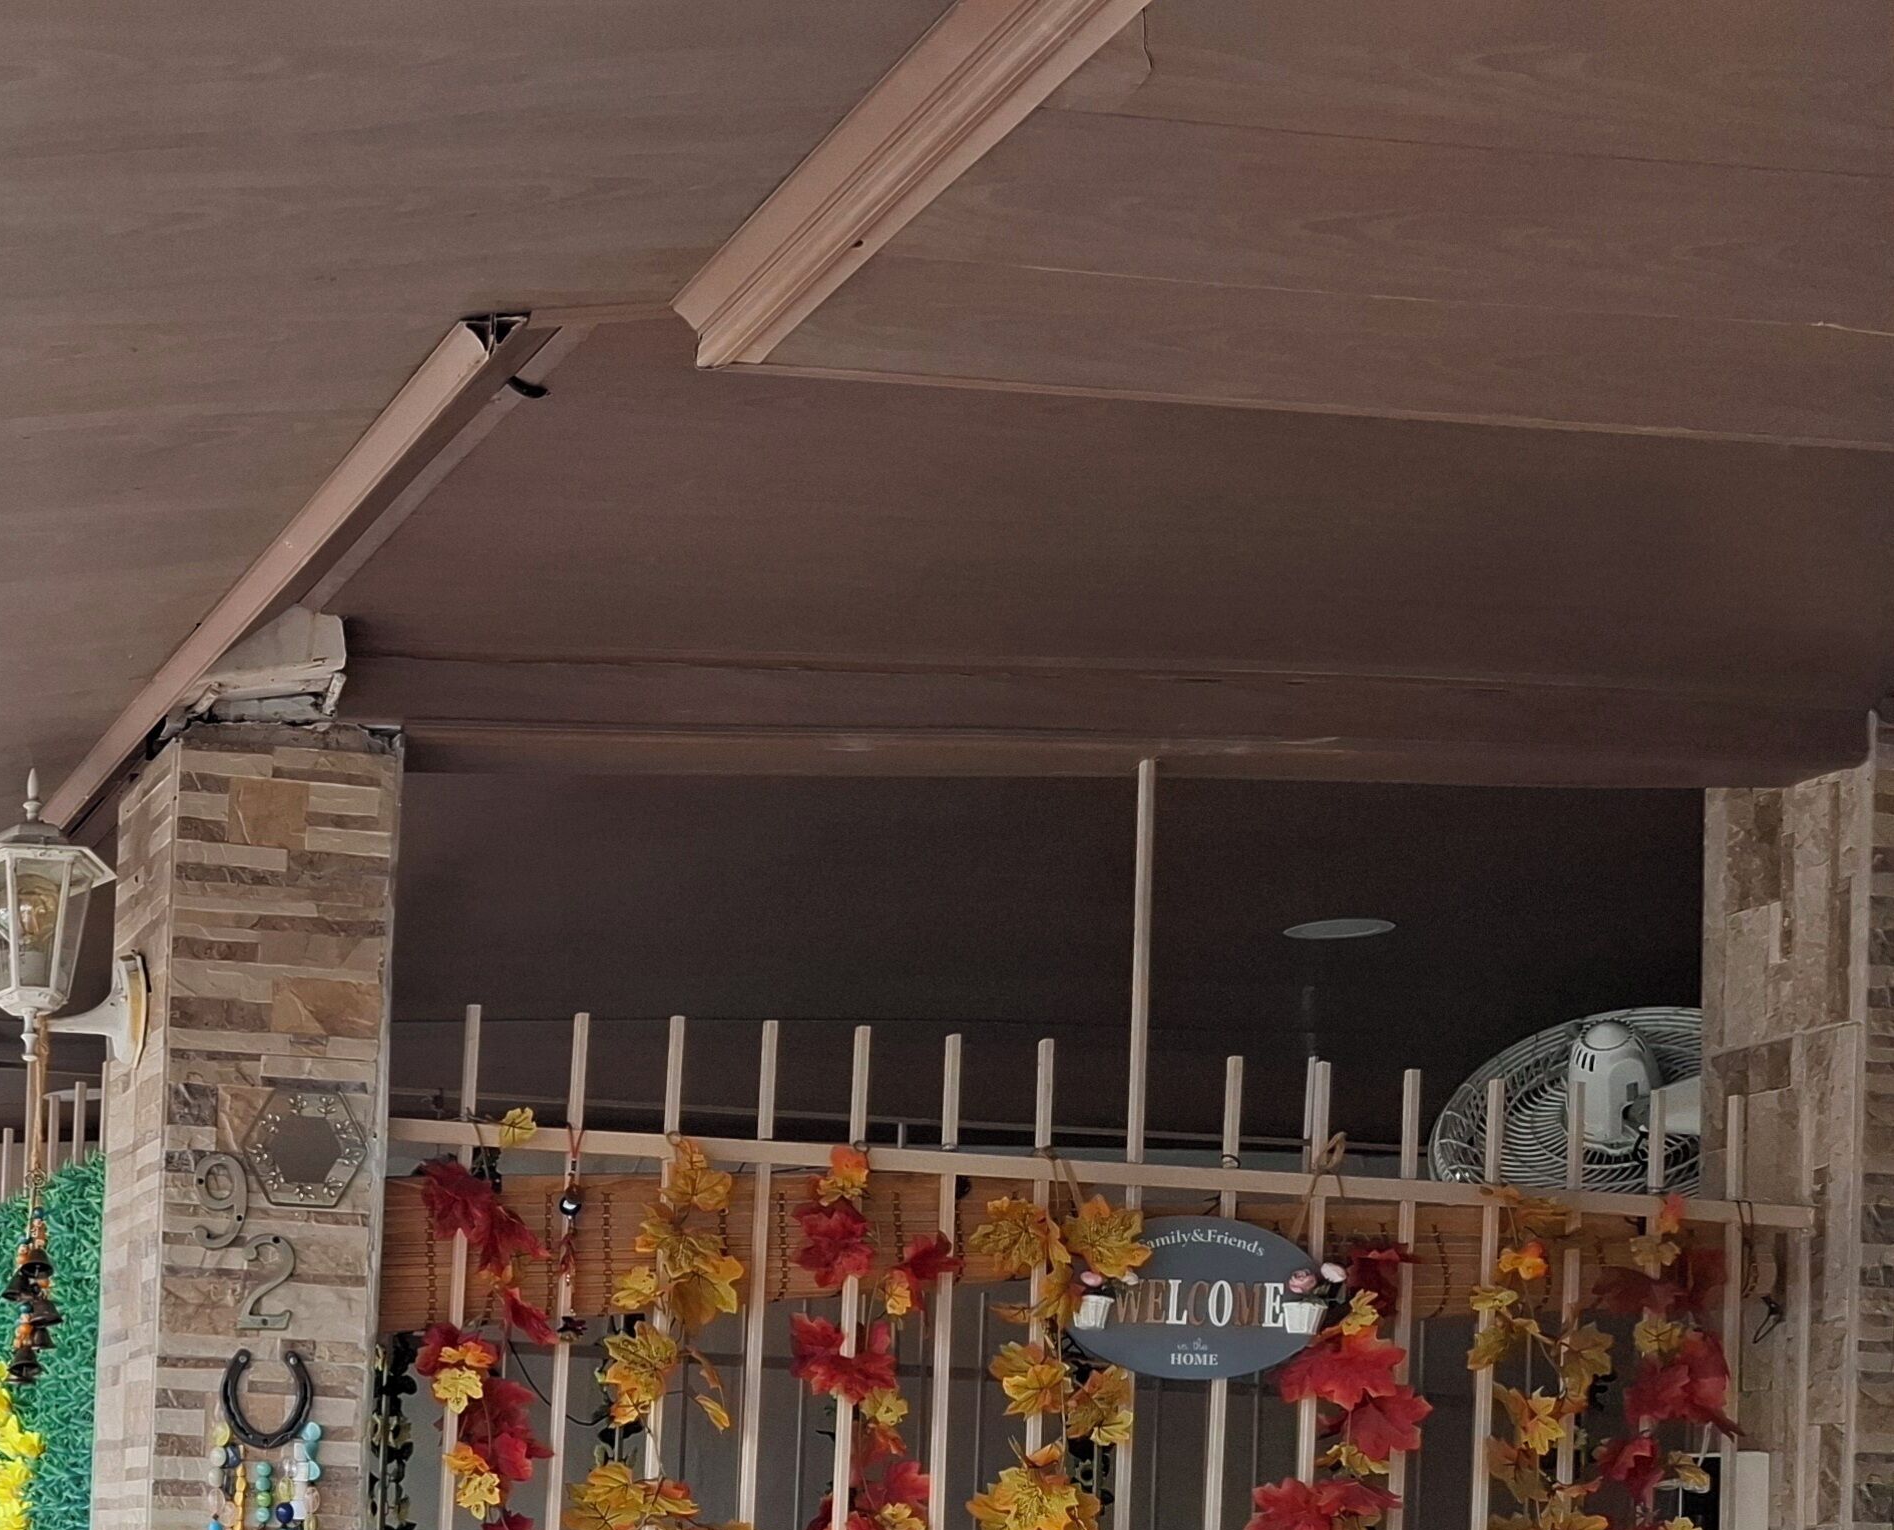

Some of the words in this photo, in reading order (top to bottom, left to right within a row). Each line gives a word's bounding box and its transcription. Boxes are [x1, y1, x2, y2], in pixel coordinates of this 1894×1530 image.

[1147, 1228, 1266, 1257] amily&Friends
[1115, 1279, 1285, 1328] WELCOME
[1170, 1353, 1219, 1367] HOME
